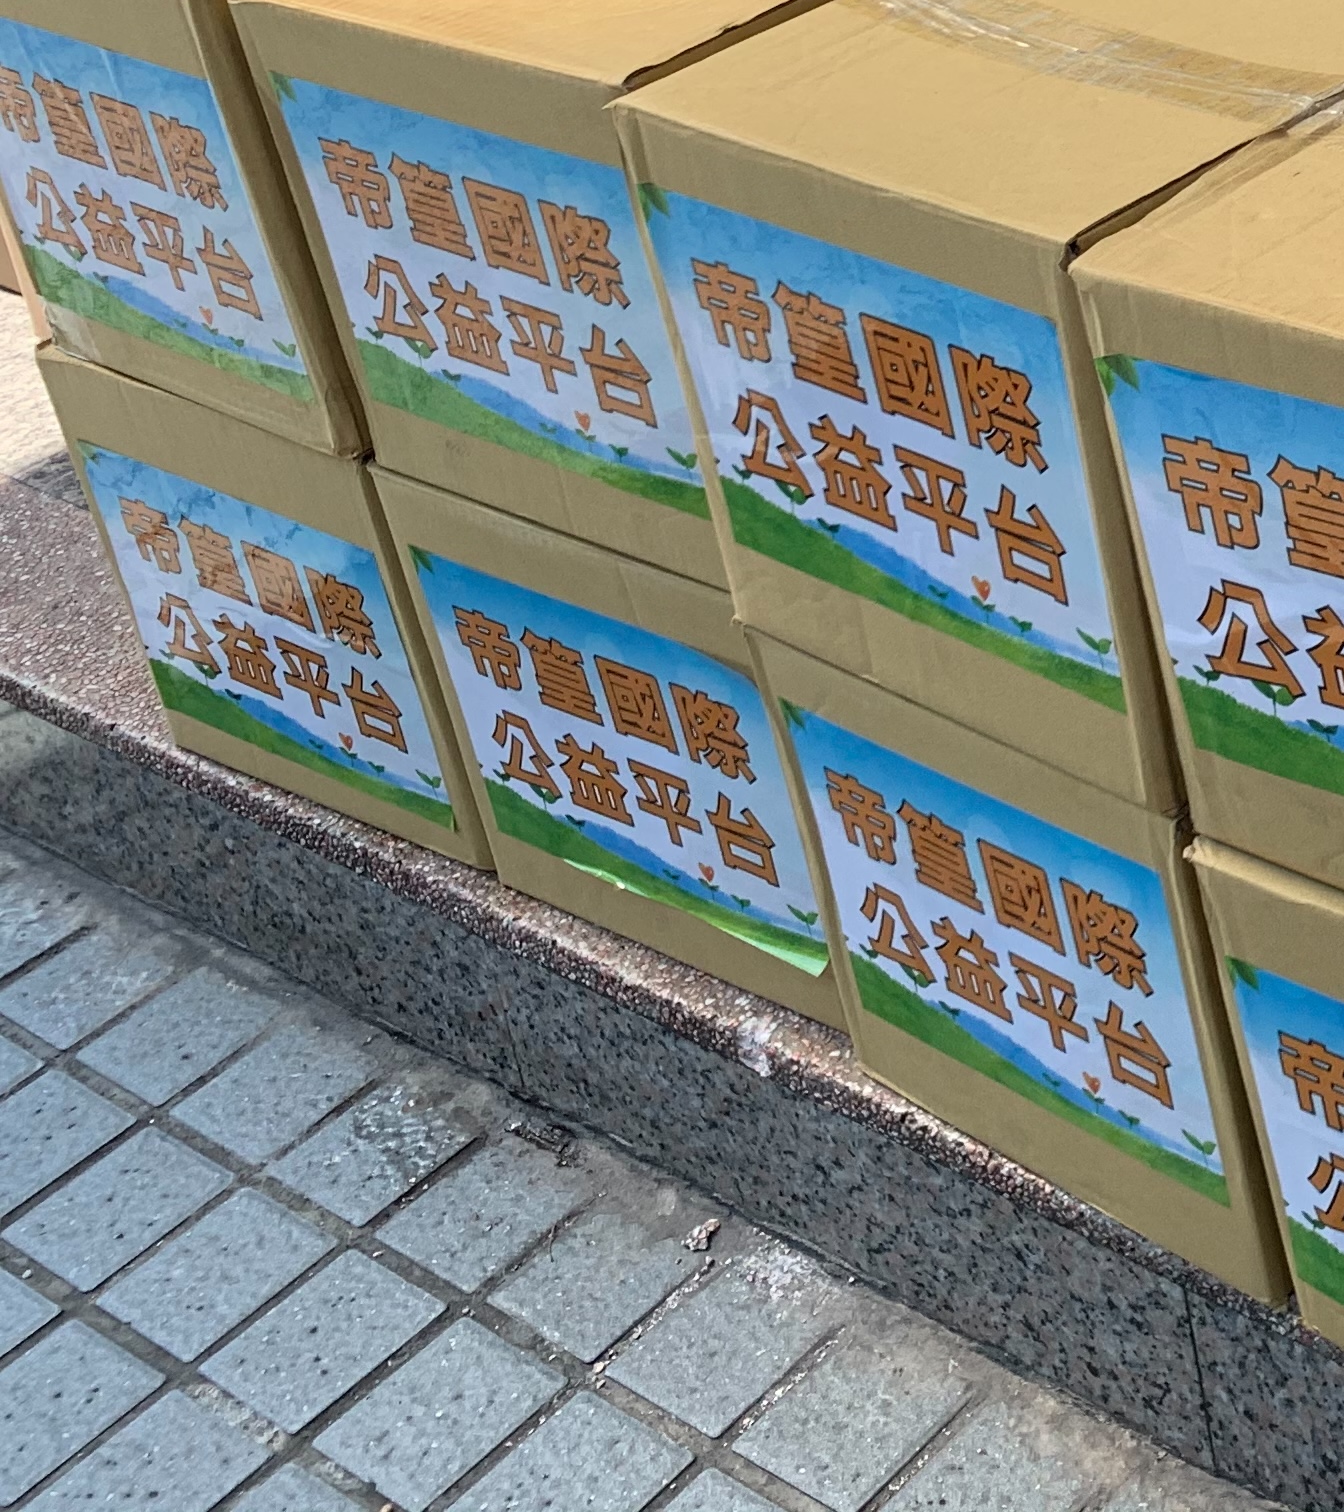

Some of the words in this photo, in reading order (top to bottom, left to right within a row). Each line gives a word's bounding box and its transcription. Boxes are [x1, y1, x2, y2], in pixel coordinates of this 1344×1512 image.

[26, 165, 263, 321] 公益平台
[316, 133, 627, 314] 帝篁國際
[362, 253, 661, 430] 公益平台
[690, 257, 1051, 475] 帝篁國際
[117, 494, 378, 662] 帝篁國際
[730, 388, 1072, 609] 公益平台
[154, 590, 411, 756] 公益平台
[451, 602, 758, 786] 帝篁國際
[491, 709, 782, 889] 公益平台
[821, 765, 1152, 998] 帝篁國際
[857, 880, 1177, 1110] 公益平台
